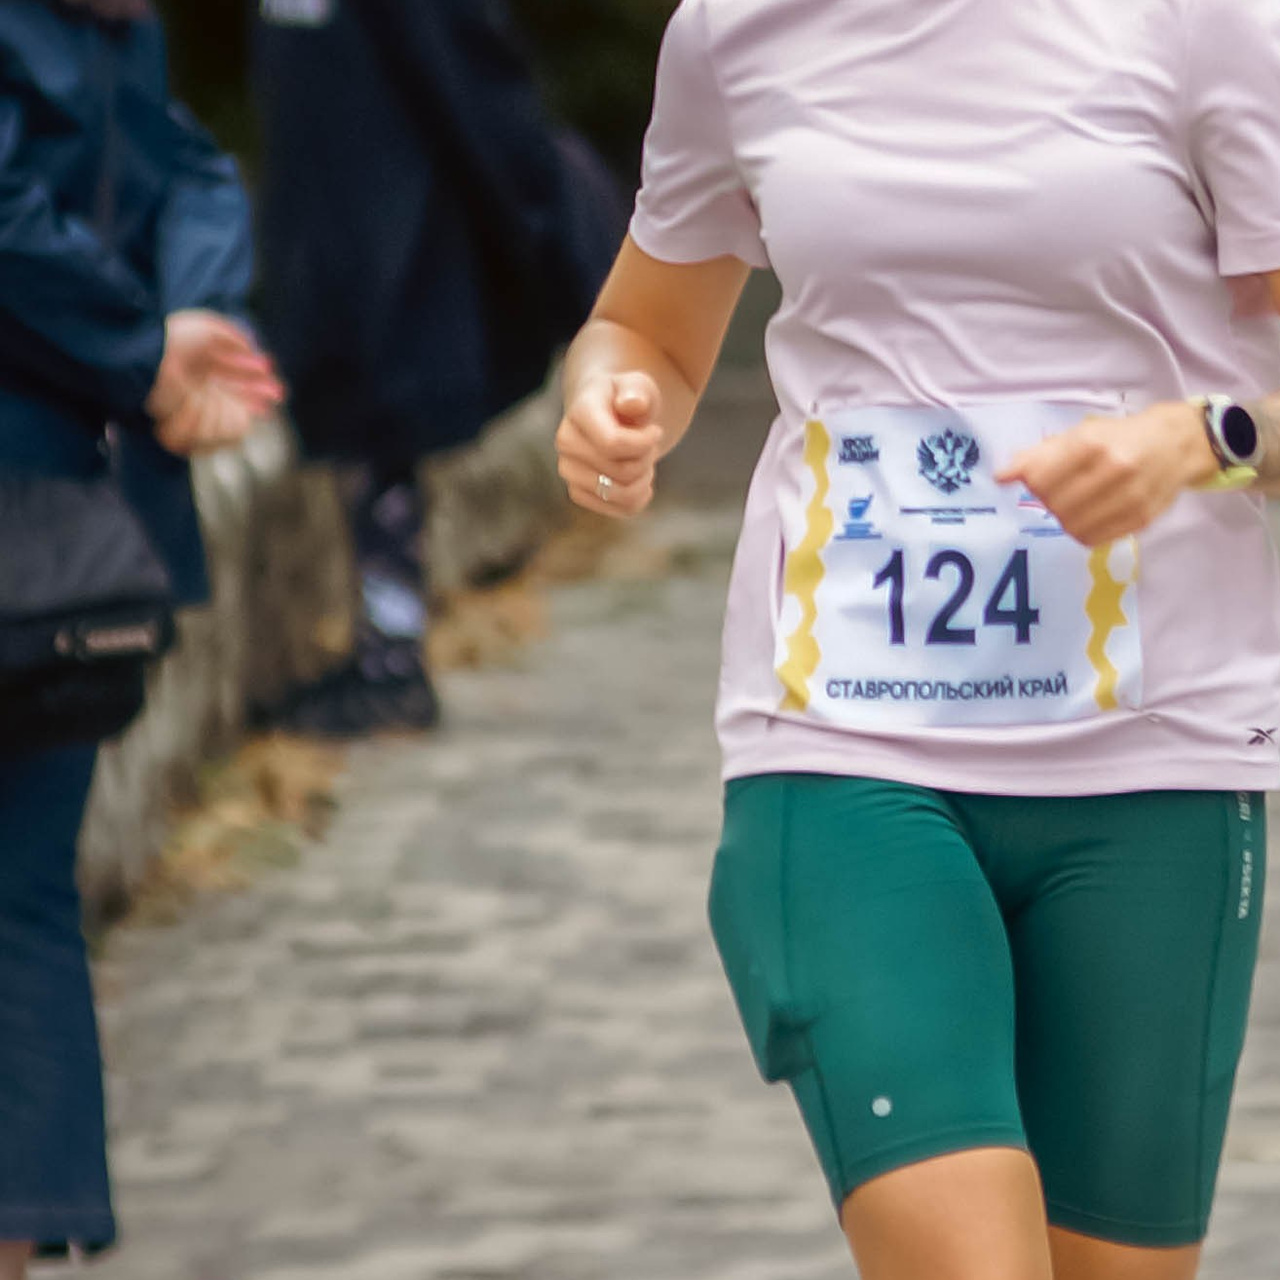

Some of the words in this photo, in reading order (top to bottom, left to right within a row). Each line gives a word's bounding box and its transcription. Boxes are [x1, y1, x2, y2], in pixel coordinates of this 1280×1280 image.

[872, 549, 1040, 645] 124
[825, 673, 1014, 701] СТАВРОПОЛЬСКИЙ
[1018, 670, 1069, 698] КРАЙ
